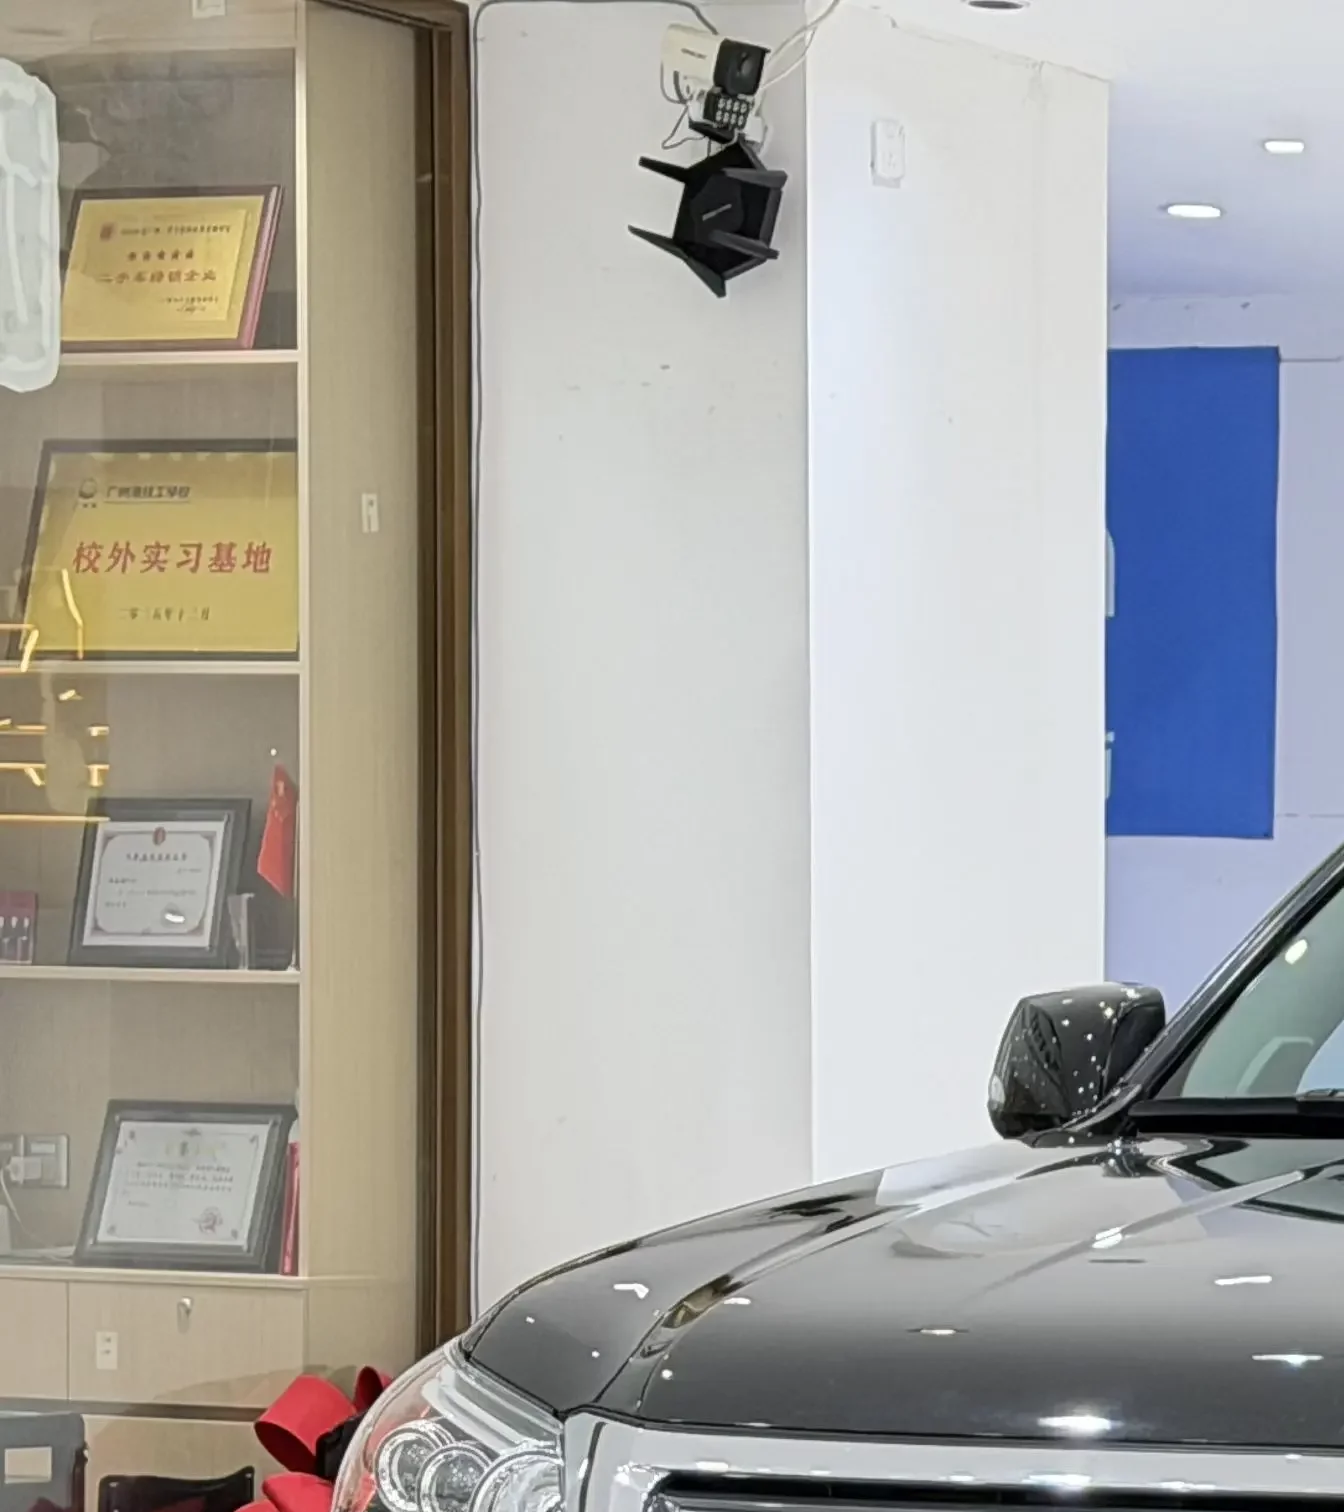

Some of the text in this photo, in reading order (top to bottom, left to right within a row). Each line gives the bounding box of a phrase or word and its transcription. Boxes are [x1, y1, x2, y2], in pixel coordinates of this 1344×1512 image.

[72, 541, 273, 574] 校外实习基地
